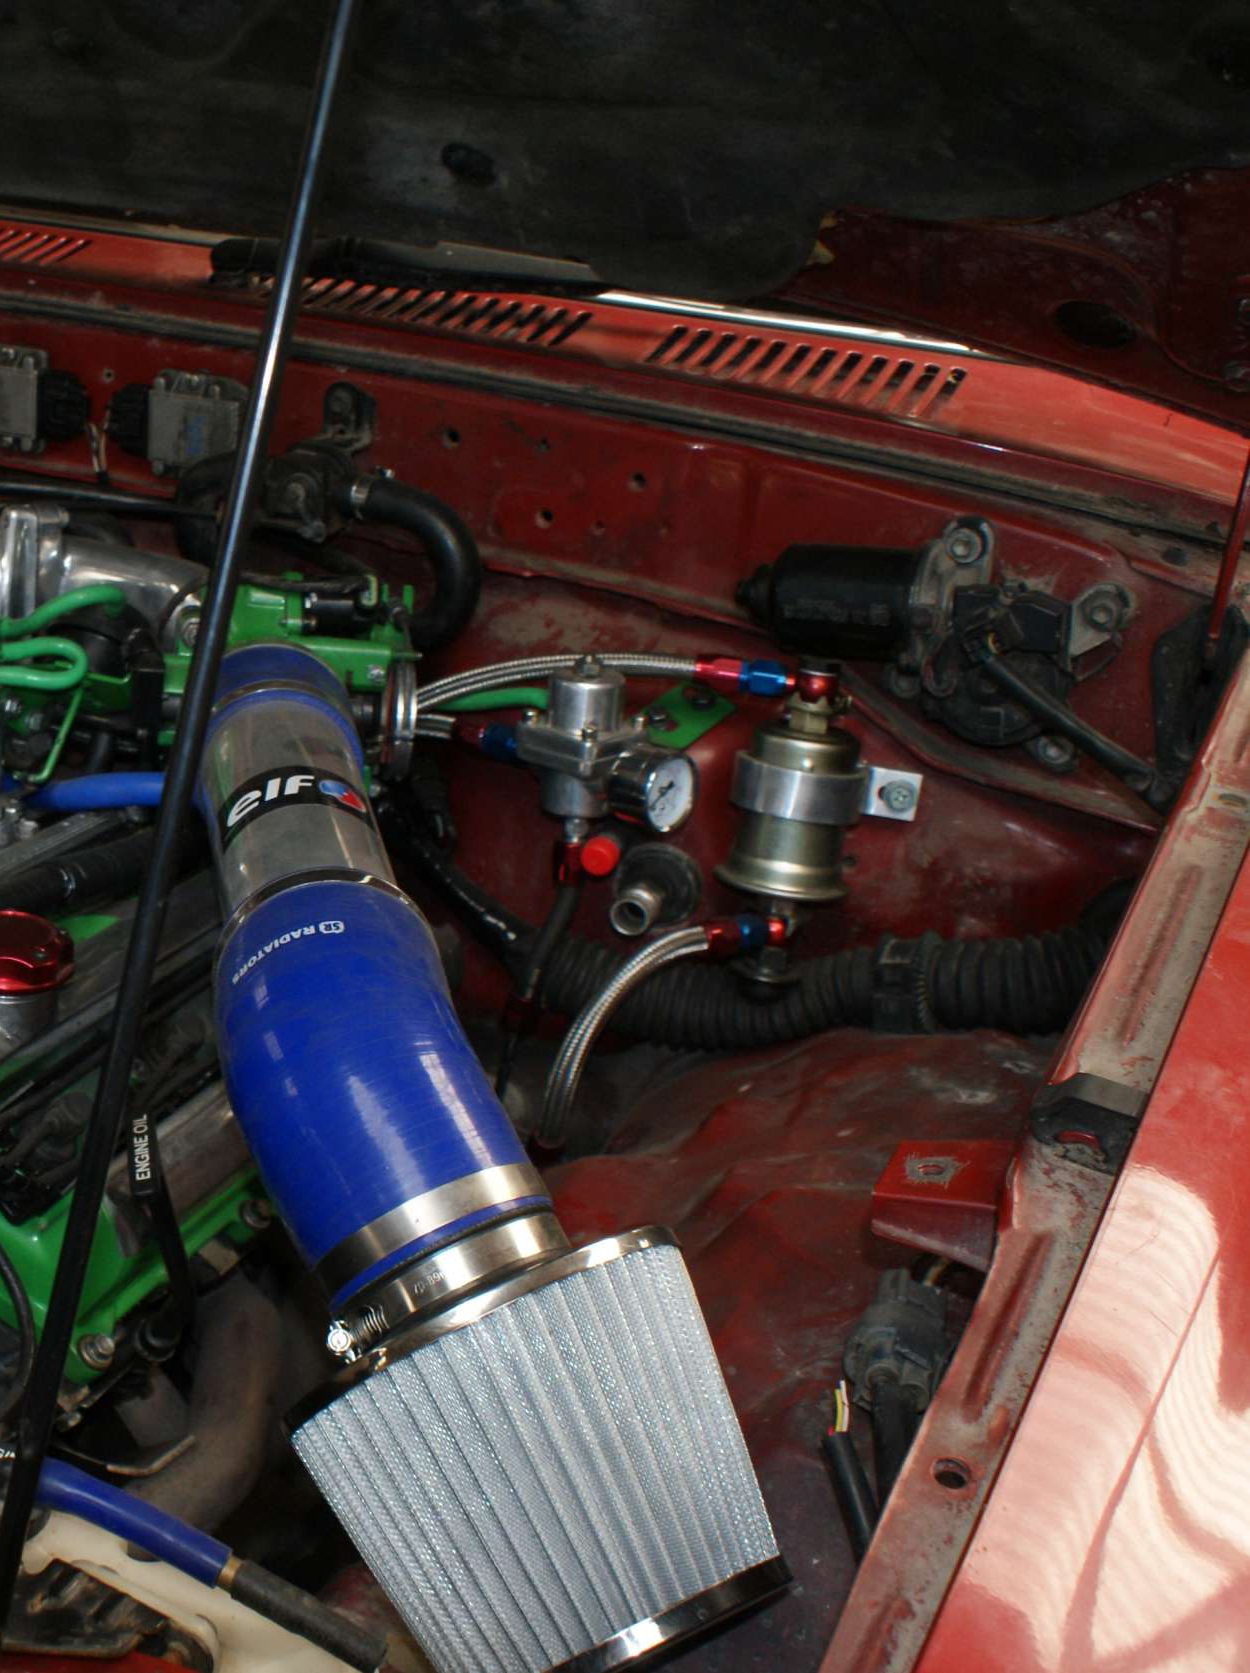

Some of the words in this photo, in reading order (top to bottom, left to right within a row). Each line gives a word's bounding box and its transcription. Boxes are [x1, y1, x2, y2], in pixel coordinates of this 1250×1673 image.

[232, 925, 316, 985] RADIATORS
[132, 1113, 149, 1134] OIL
[133, 1134, 151, 1181] ENGINE
